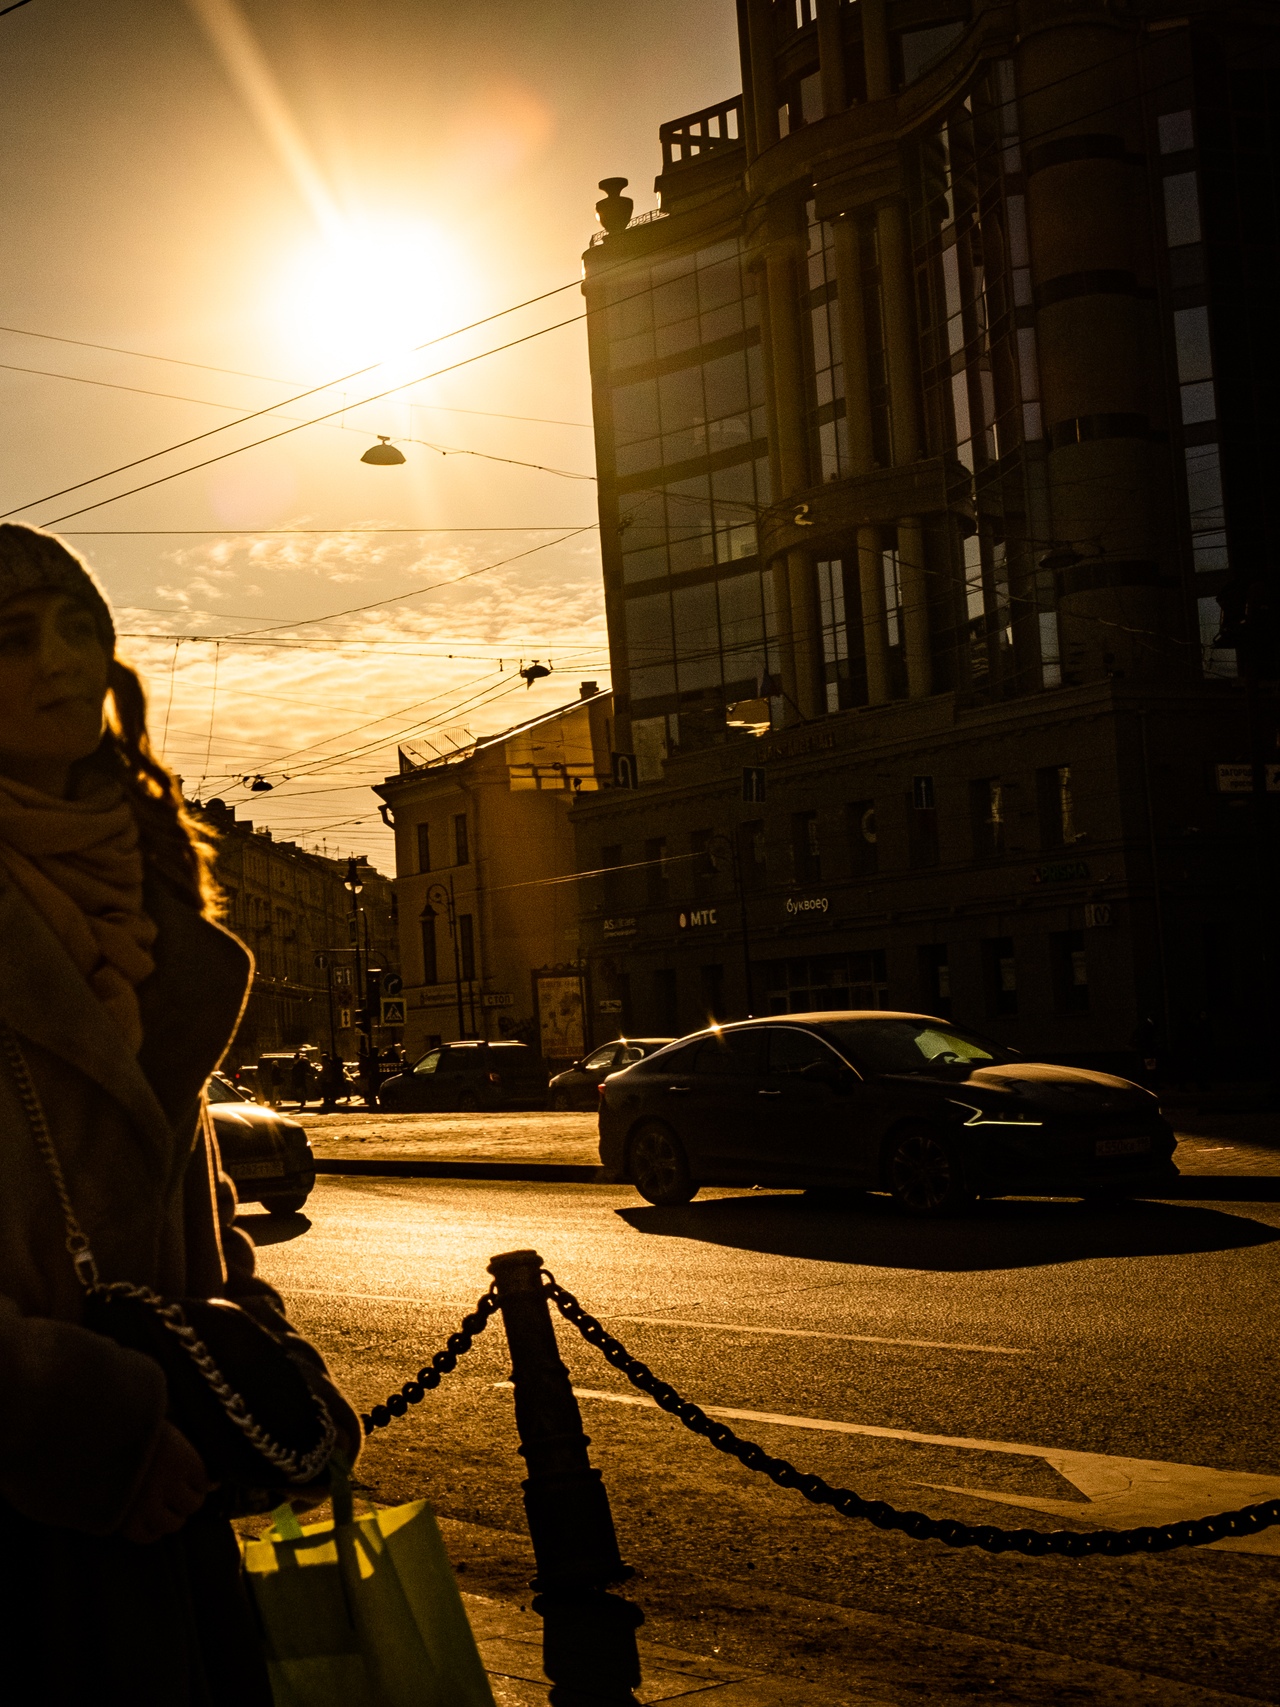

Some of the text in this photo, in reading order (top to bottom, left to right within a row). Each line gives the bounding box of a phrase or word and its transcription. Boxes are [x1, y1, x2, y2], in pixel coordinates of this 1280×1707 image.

[1041, 862, 1088, 882] PRISMA
[690, 908, 717, 927] МТС
[488, 995, 510, 1005] СТОП
